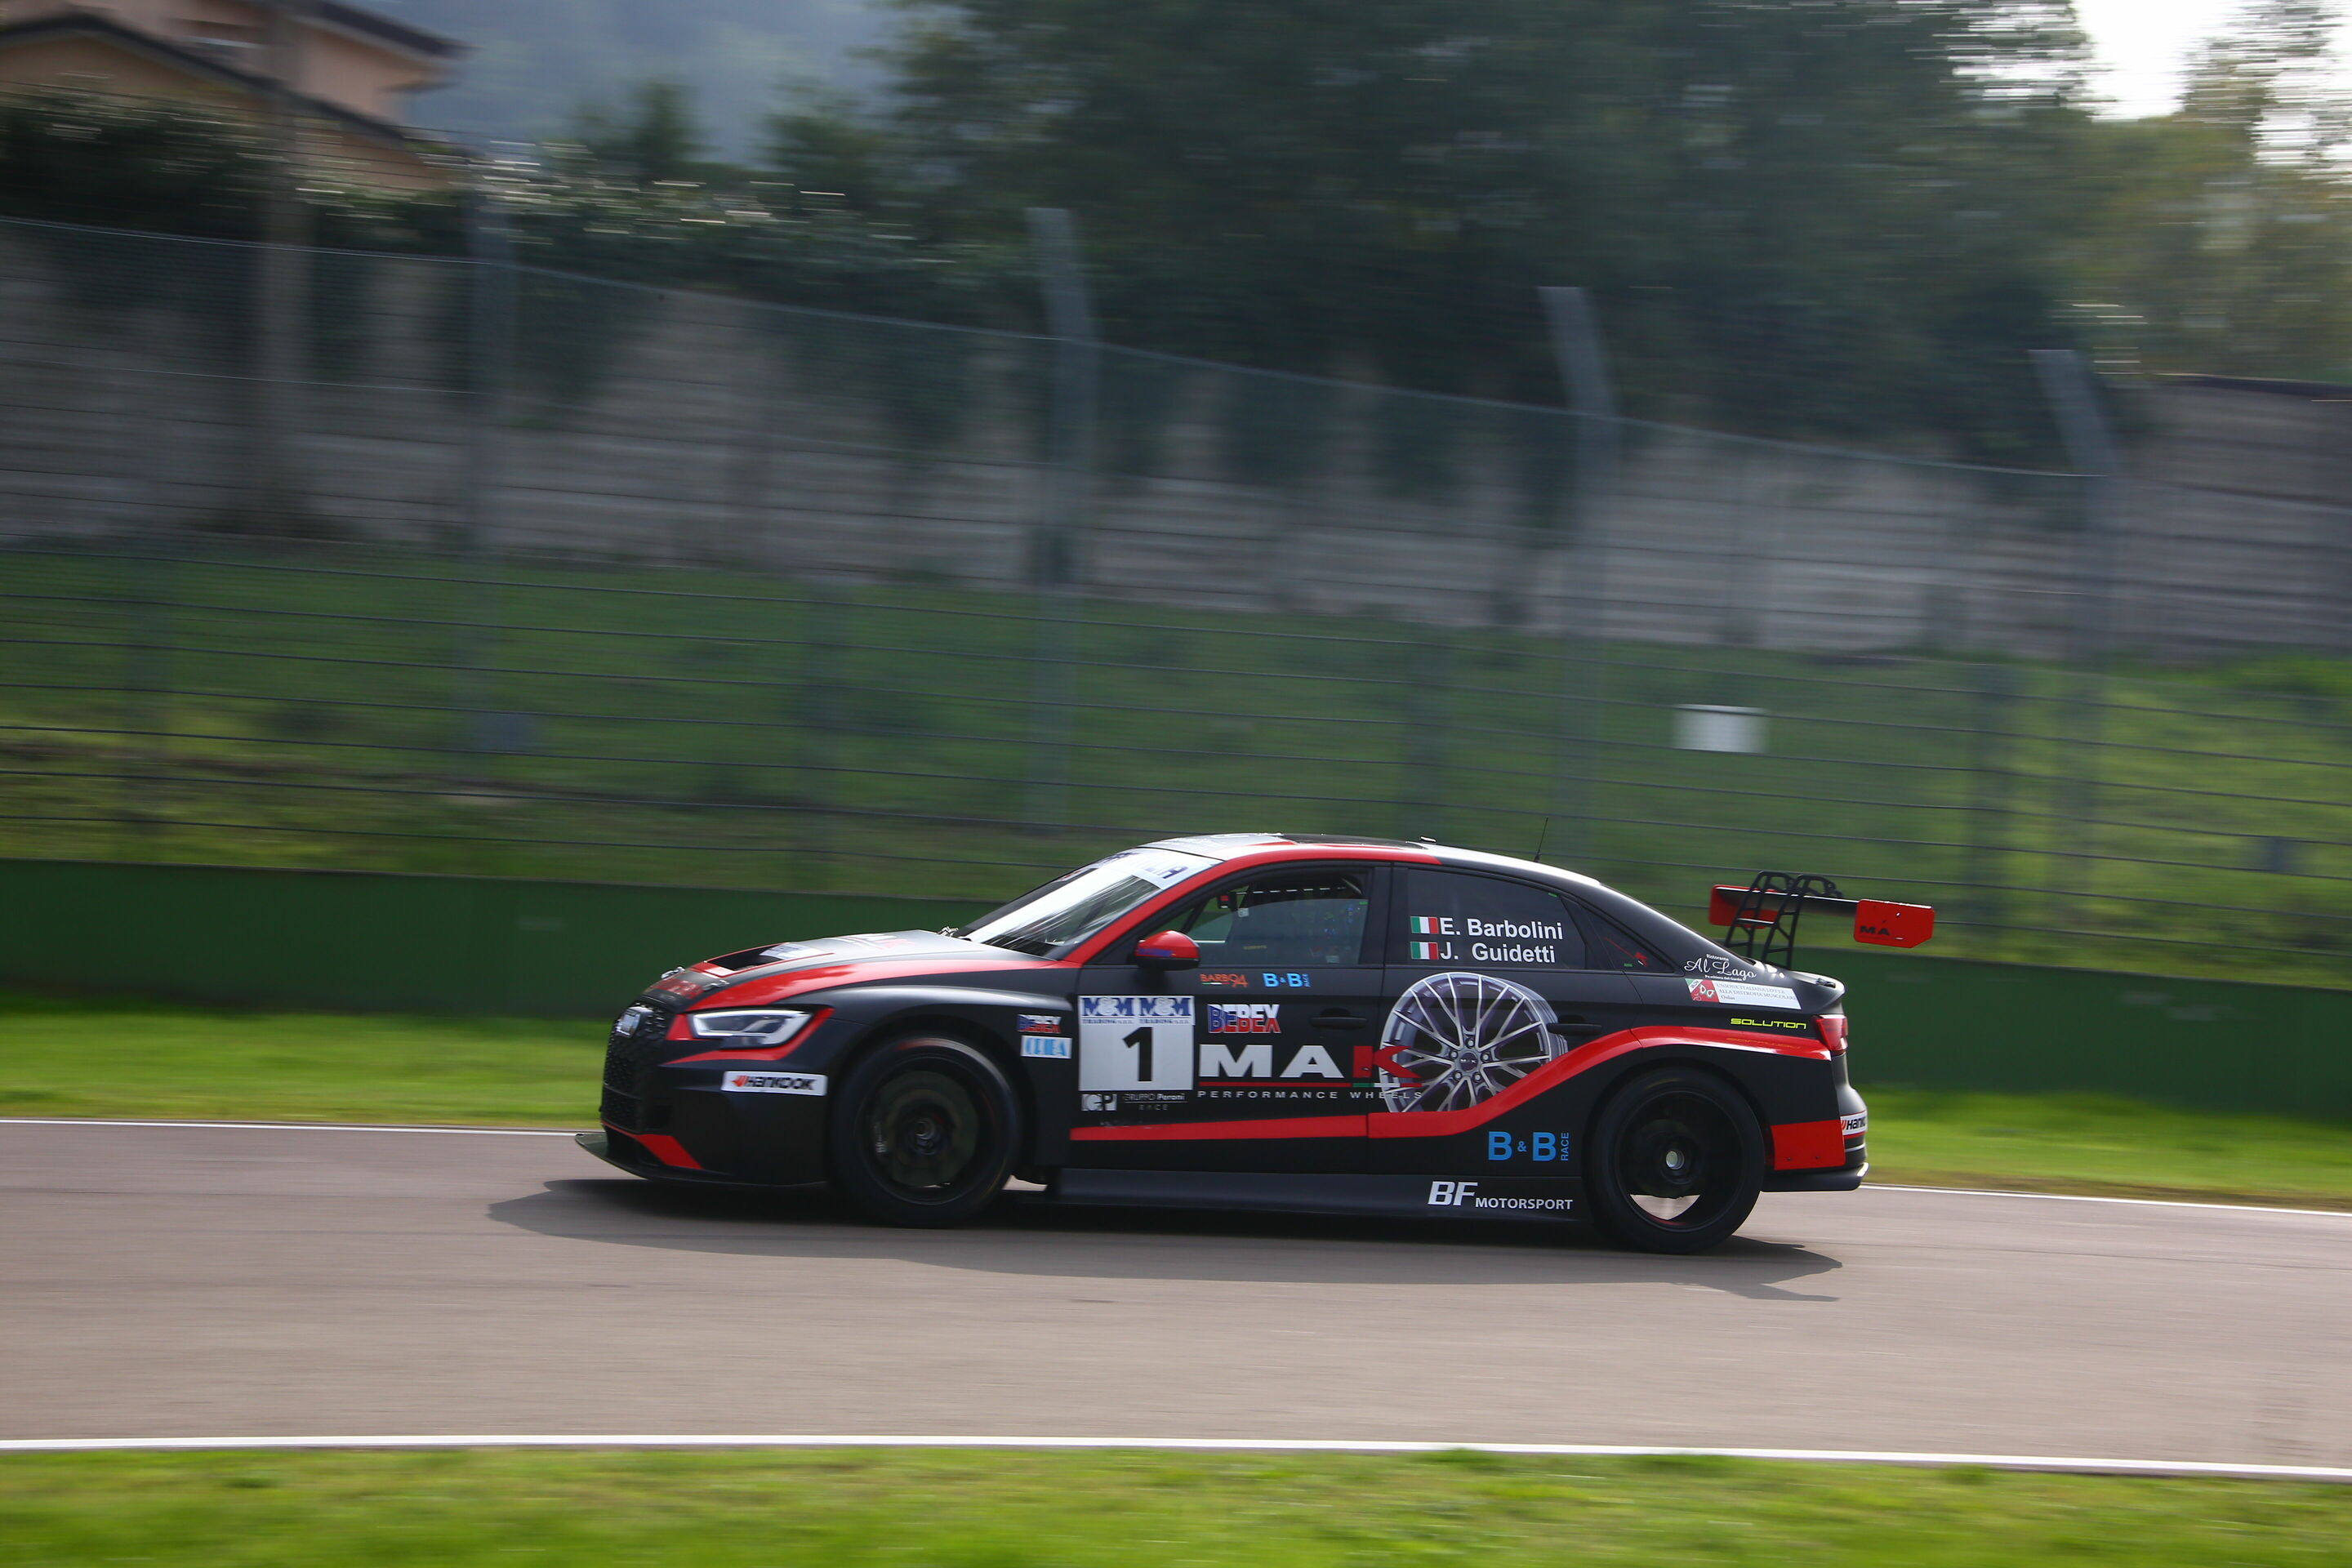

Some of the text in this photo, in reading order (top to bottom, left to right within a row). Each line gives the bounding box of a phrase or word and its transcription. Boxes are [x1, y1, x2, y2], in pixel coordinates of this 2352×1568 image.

[1439, 917, 1564, 940] E. Barbolini
[1440, 942, 1556, 964] J. Guidetti
[1684, 957, 1757, 982] Al Lago
[1731, 1018, 1806, 1030] SOLUTION
[1122, 1027, 1153, 1082] 1
[1199, 1045, 1422, 1079] MAK
[1197, 1089, 1423, 1099] PERFORMANCE WHEELS
[1488, 1131, 1570, 1161] B & B RACE
[1428, 1181, 1574, 1209] BF MOTORSPORT
